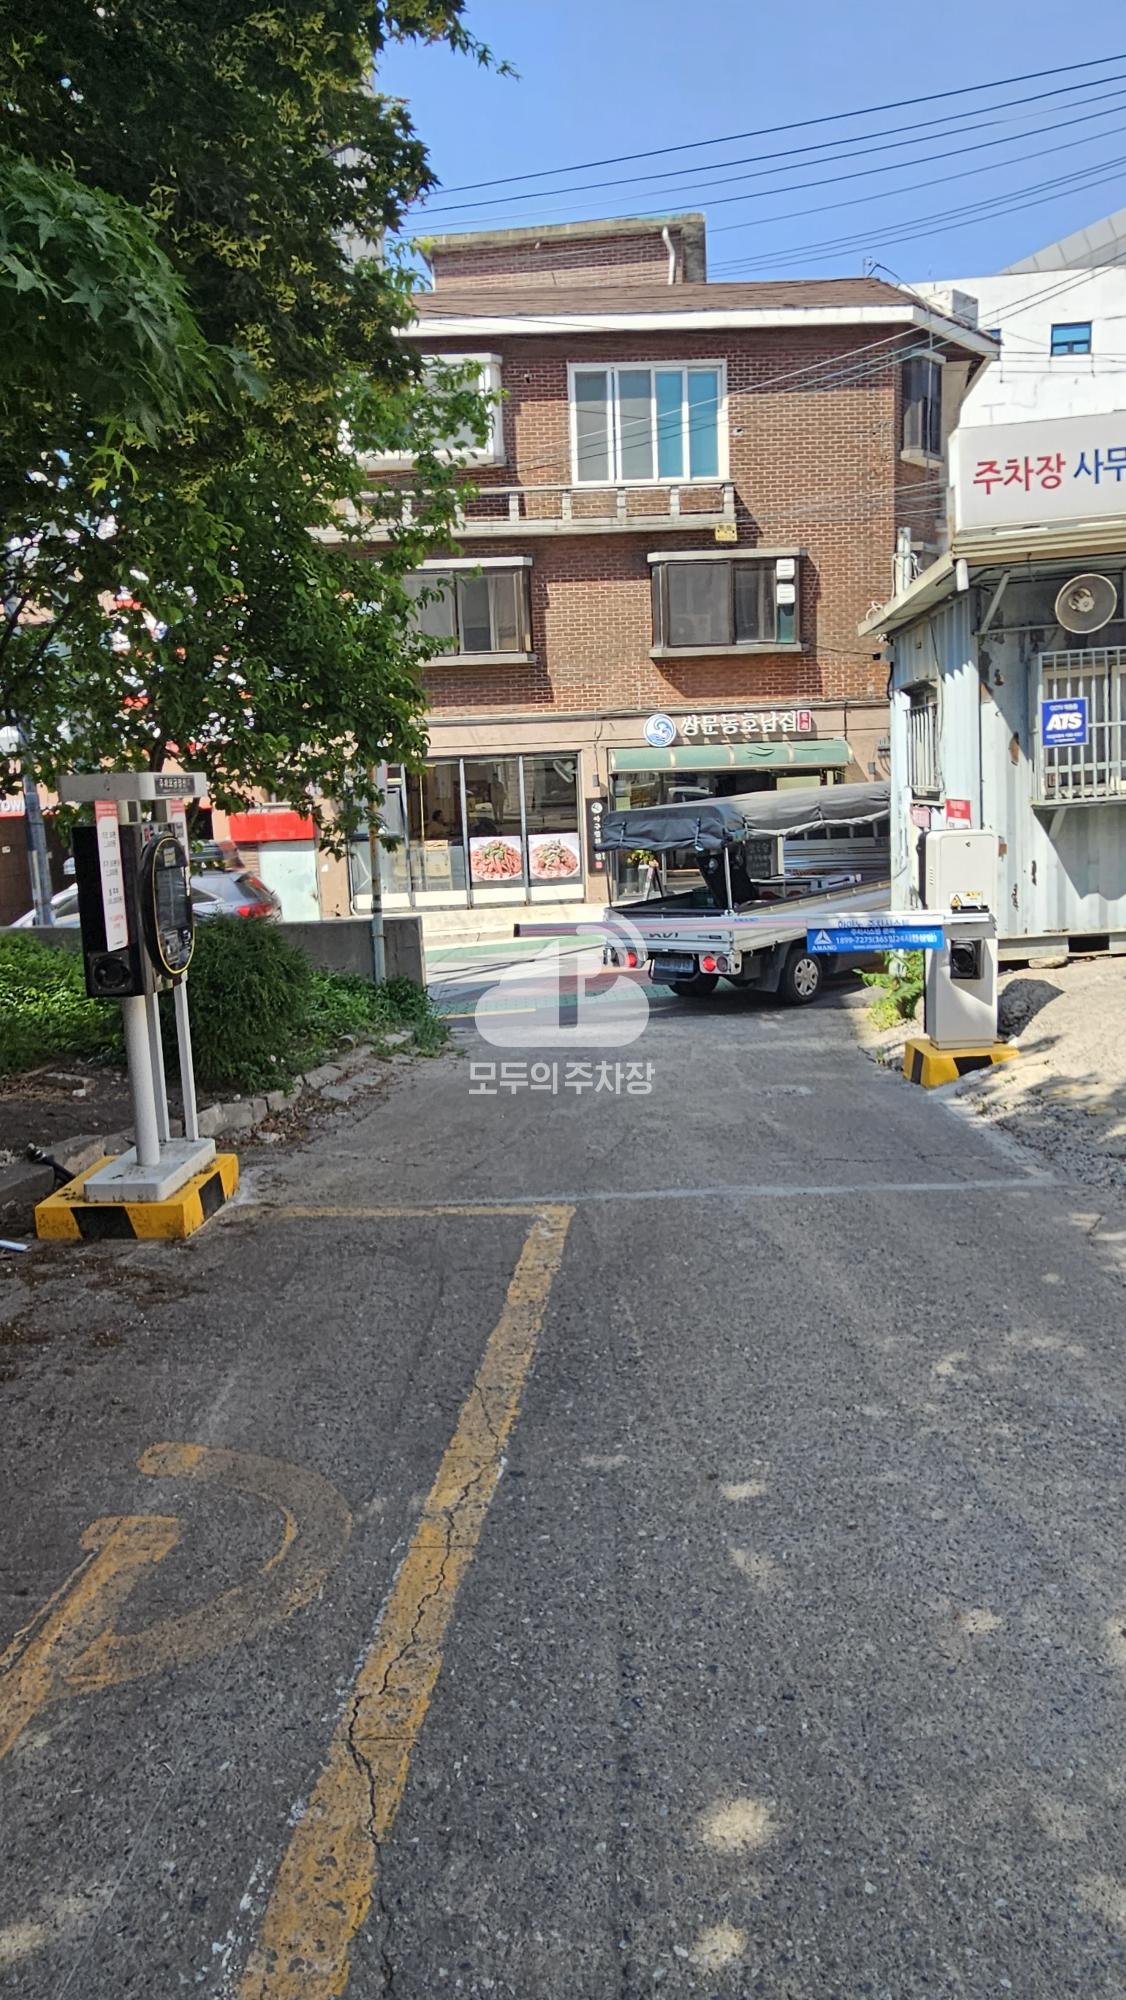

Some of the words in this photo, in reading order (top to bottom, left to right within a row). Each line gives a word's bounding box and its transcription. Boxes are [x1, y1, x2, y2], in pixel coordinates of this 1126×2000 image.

[973, 452, 1067, 496] 주차장
[681, 709, 797, 737] 쌍문동호남집
[1045, 712, 1083, 731] ATS
